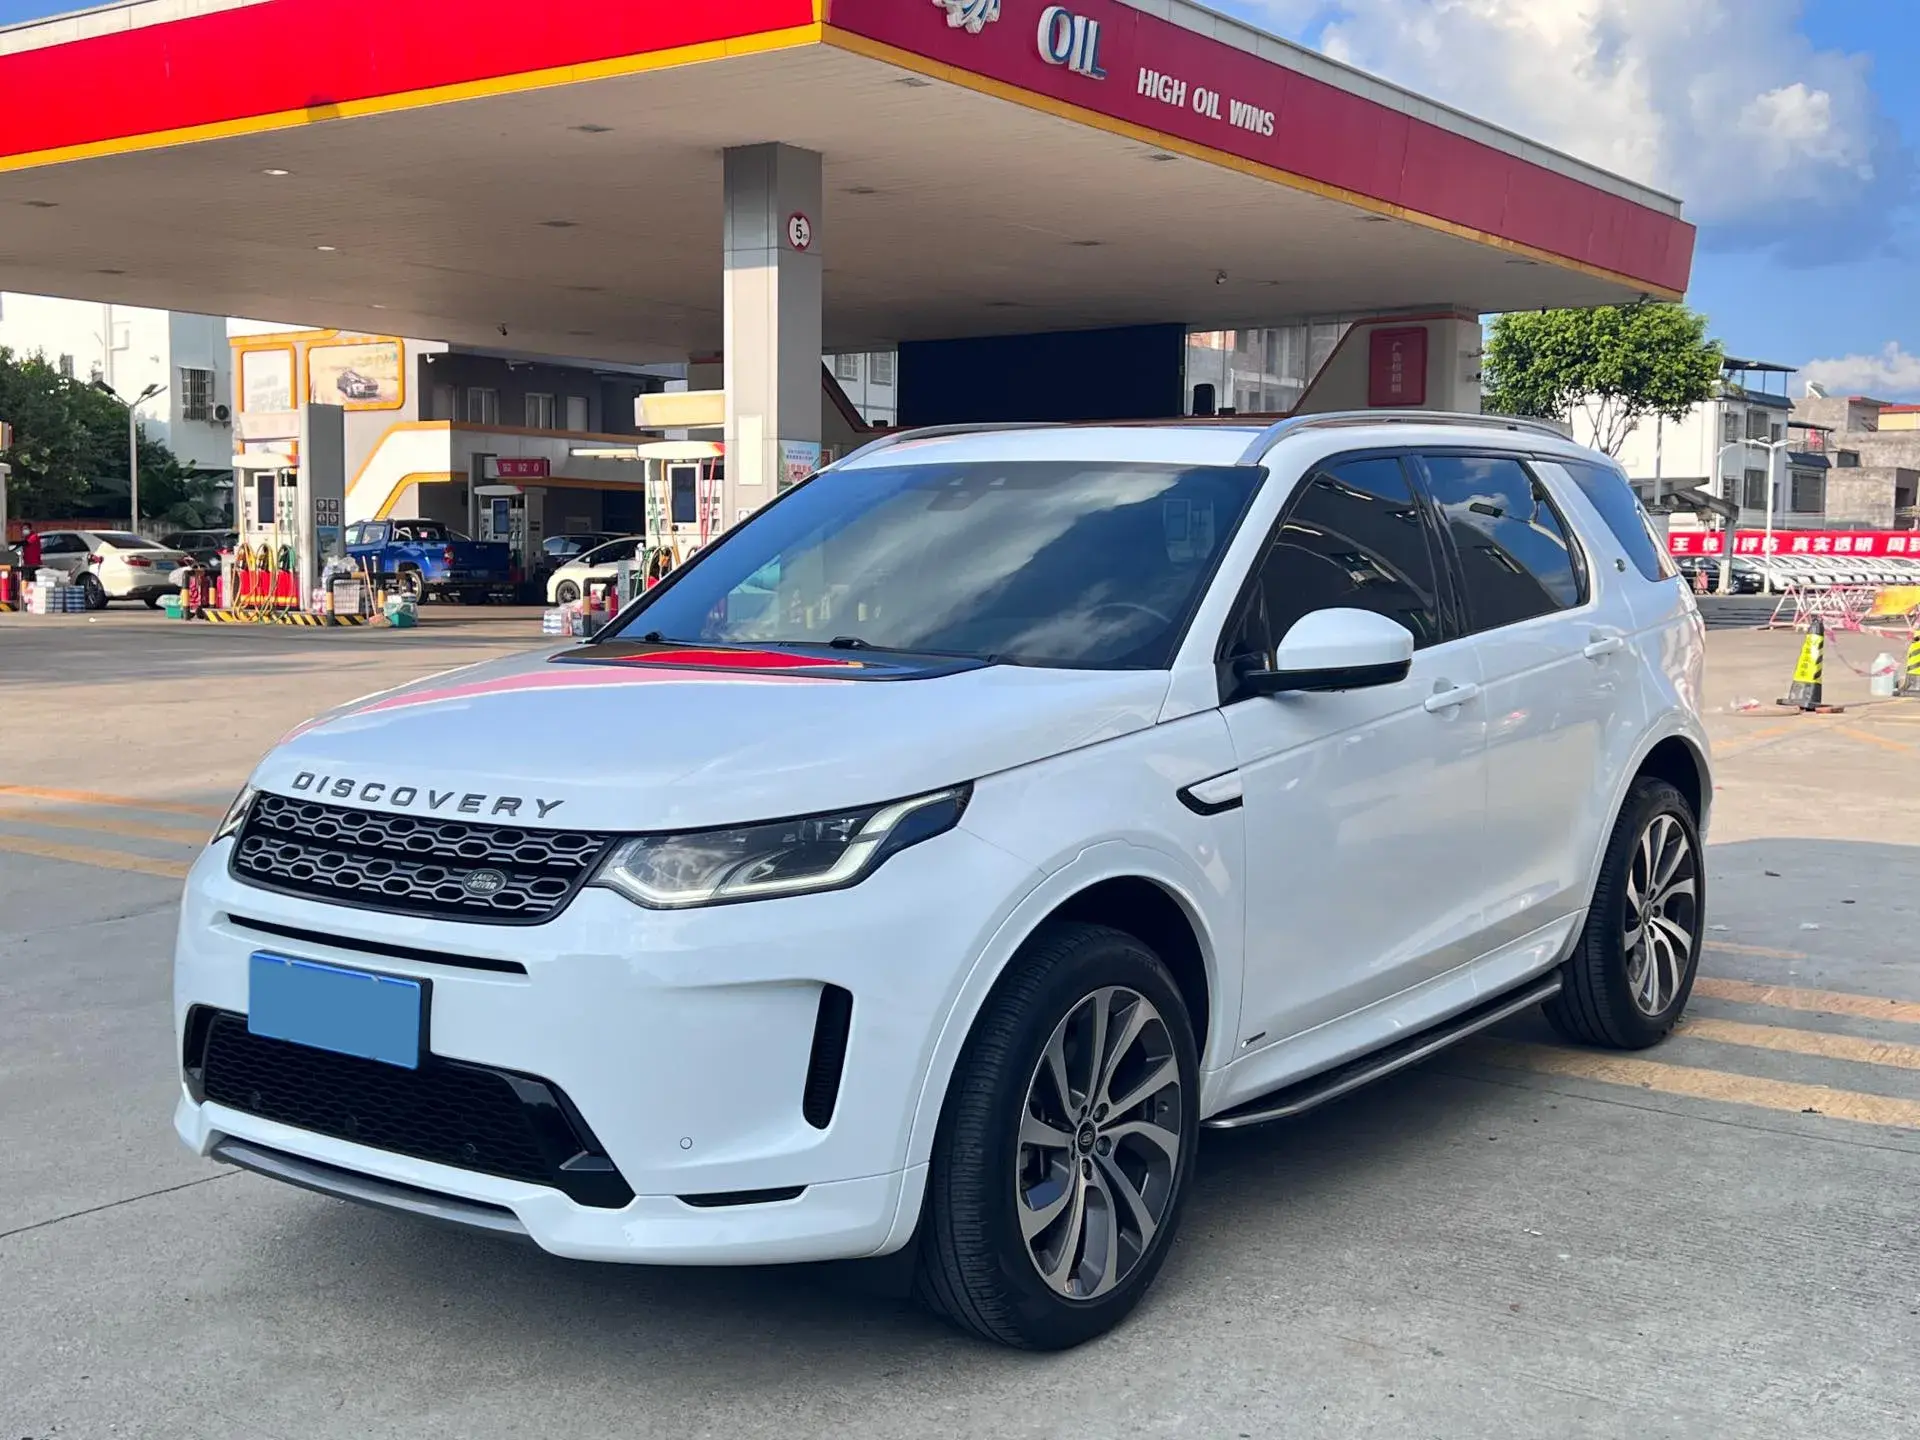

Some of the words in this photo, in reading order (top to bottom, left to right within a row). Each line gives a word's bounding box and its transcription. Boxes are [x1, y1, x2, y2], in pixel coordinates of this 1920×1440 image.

[1037, 6, 1107, 80] OIL
[1137, 67, 1187, 107] HIGH
[1192, 87, 1222, 120] OIL
[1229, 98, 1275, 136] WINS
[795, 223, 803, 240] 5
[1792, 536, 1874, 553] 真实透明
[292, 771, 565, 819] DISCOVERY
